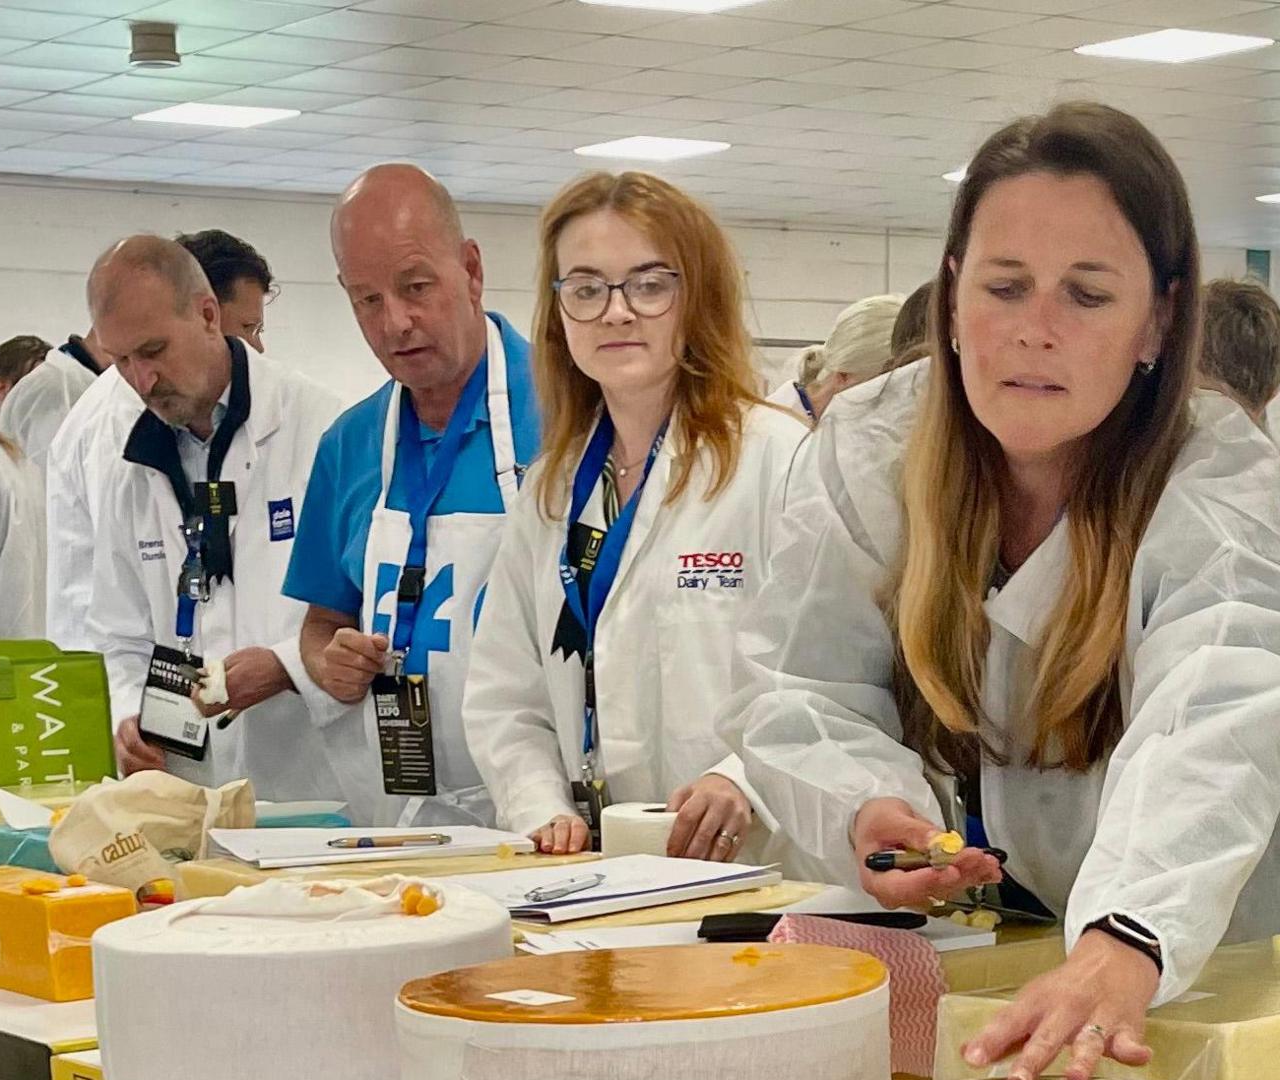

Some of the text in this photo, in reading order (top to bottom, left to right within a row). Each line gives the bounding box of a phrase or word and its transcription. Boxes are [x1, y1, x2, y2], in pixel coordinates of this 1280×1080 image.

[677, 552, 744, 568] TESCO
[677, 575, 744, 590] Dairy Team
